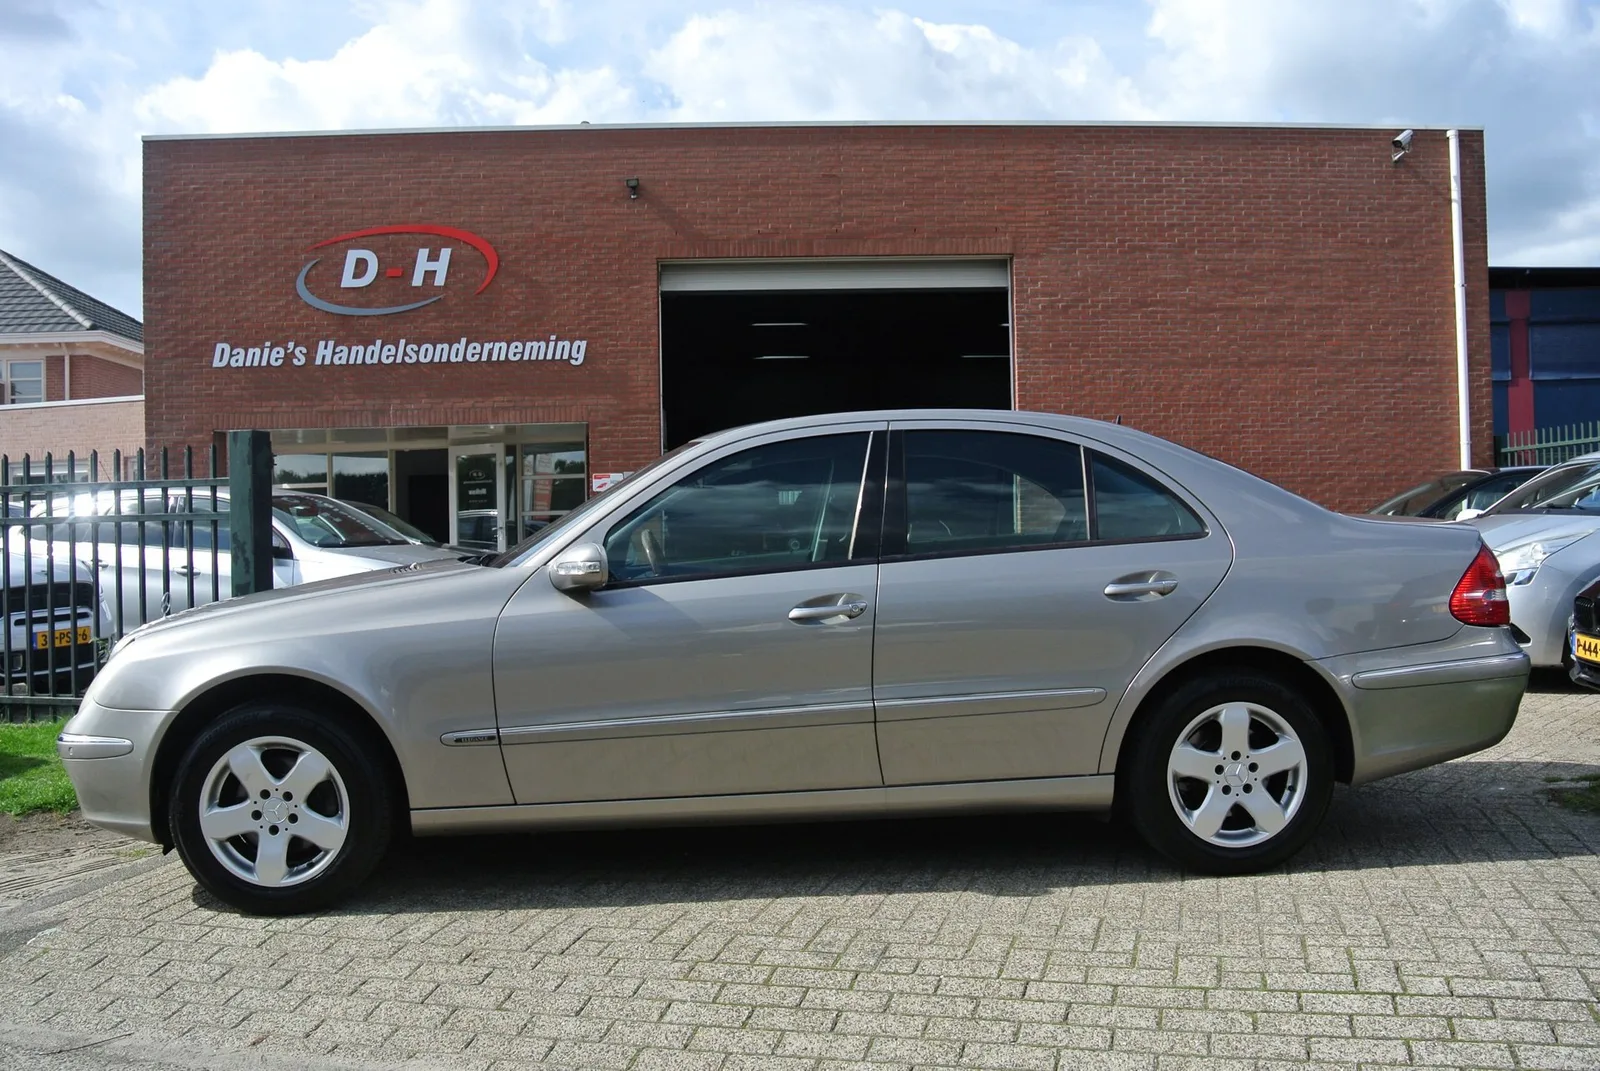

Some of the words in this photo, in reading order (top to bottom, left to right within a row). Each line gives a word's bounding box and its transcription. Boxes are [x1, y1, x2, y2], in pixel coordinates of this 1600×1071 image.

[340, 248, 452, 288] D-H
[212, 341, 307, 368] Danie's
[315, 335, 587, 366] Handelsonderneming
[41, 629, 88, 647] 3-PS-6
